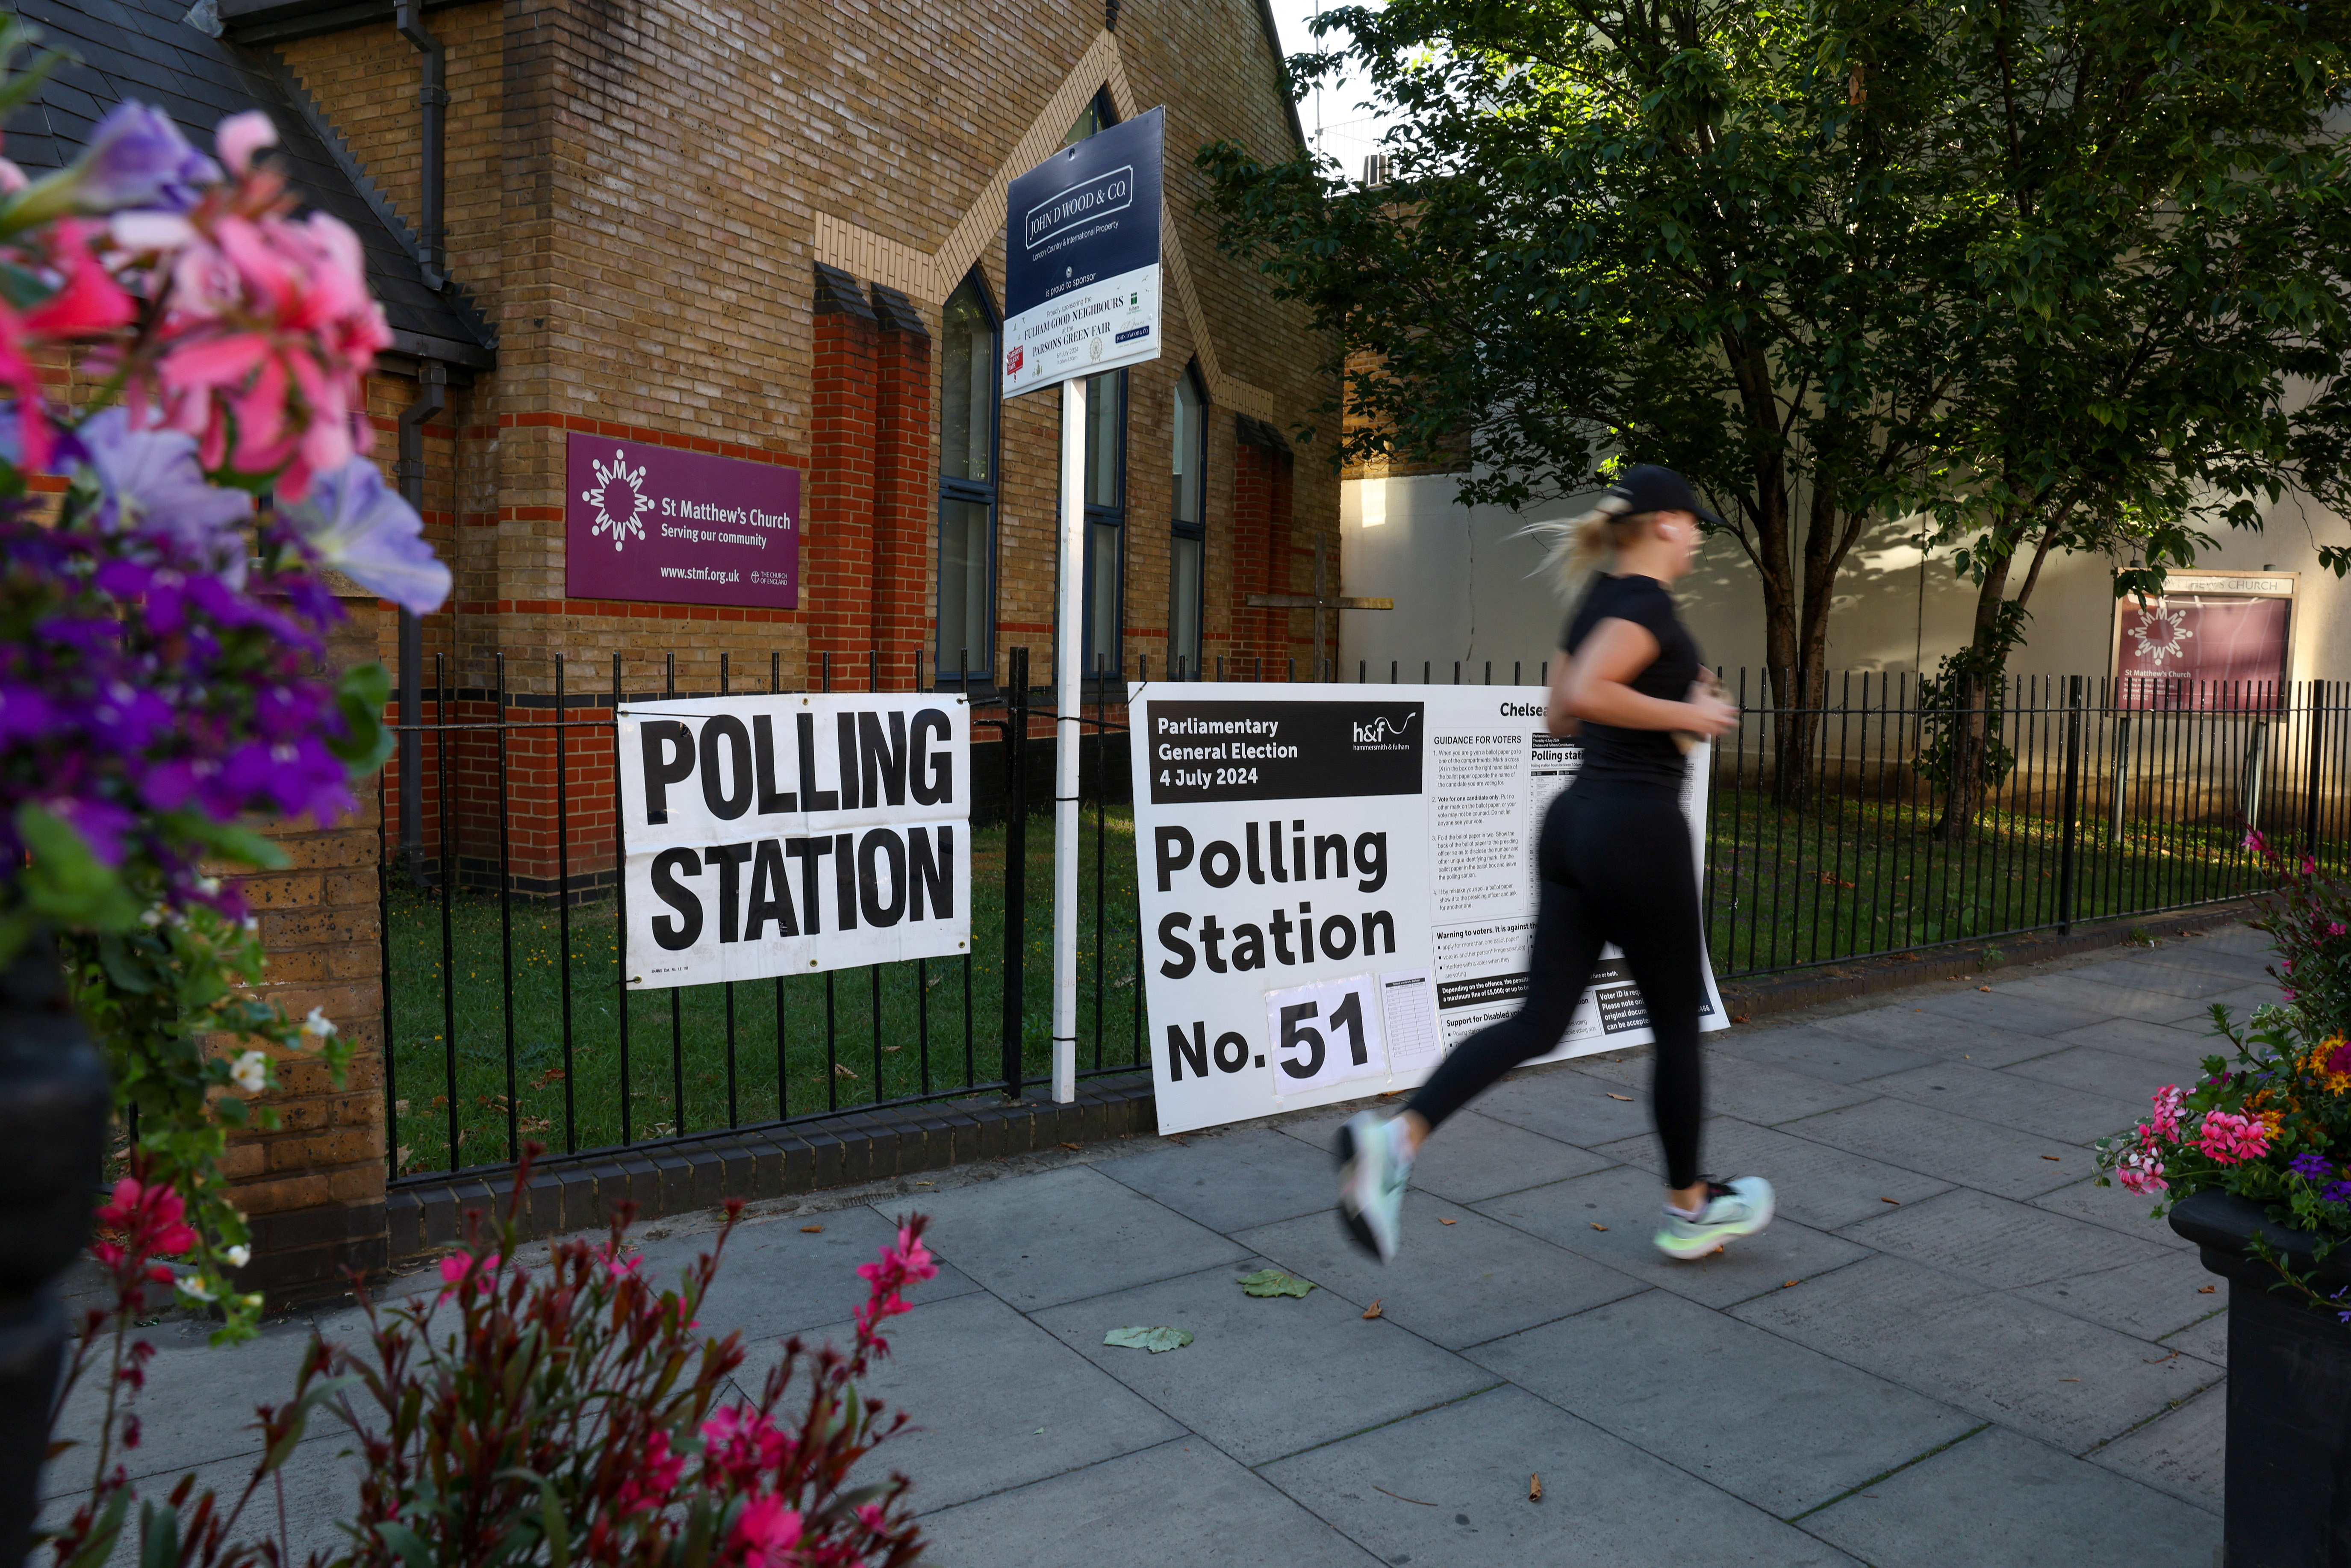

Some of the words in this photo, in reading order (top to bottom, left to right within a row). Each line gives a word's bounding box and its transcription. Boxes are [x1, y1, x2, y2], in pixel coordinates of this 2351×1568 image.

[1030, 210, 1052, 240] JOHN
[1054, 207, 1060, 222] D
[1062, 192, 1093, 218] WOOD
[1097, 189, 1105, 204] &
[1108, 180, 1125, 200] CO.
[1033, 249, 1046, 261] London,
[1047, 242, 1062, 253] Country
[1067, 229, 1094, 244] International
[1096, 220, 1119, 233] Property
[1046, 289, 1049, 297] is
[1051, 282, 1064, 296] proud
[1066, 280, 1071, 289] to
[1073, 272, 1096, 286] sponsor
[1025, 322, 1049, 340] FULHAM
[1052, 313, 1069, 328] GOOD
[1073, 295, 1123, 321] NEIGHBOURS
[1047, 307, 1061, 317] Proudly
[1062, 300, 1084, 312] sponsoring
[1034, 337, 1061, 357] PARSONS
[1064, 328, 1089, 345] GREEN
[1092, 321, 1110, 336] FAIR
[1008, 348, 1022, 359] PARSONS
[1008, 355, 1019, 365] GREEN
[1069, 347, 1078, 355] 2024
[662, 497, 676, 516] St
[681, 500, 746, 524] Matthew's
[750, 509, 790, 529] Church
[662, 523, 698, 542] Serving
[701, 531, 716, 541] our
[719, 532, 766, 549] community
[661, 567, 739, 583] www.stmf.org.uk
[2229, 580, 2277, 590] CHURCH
[1158, 717, 1279, 737] Parliamentary
[1353, 722, 1385, 743] h&f
[1158, 743, 1226, 760] General
[1232, 742, 1298, 759] Election
[1532, 751, 1562, 762] Polling
[640, 708, 953, 825] POLLING
[1160, 769, 1170, 786] 4
[1176, 769, 1211, 790] July
[1217, 767, 1258, 785] 2024
[1155, 819, 1387, 893] Polling
[651, 825, 954, 951] STATION
[1158, 902, 1396, 979] Station
[1437, 931, 1463, 939] Warning
[1508, 923, 1529, 932] against
[1442, 985, 1468, 994] Depending
[1600, 991, 1615, 1001] Voter
[1624, 989, 1628, 997] is
[1602, 1001, 1620, 1011] Please
[1621, 1000, 1634, 1008] note
[1635, 999, 1645, 1007] onl
[1604, 1010, 1627, 1021] original
[1628, 1008, 1648, 1017] docum
[1447, 1017, 1472, 1026] Support
[1484, 1011, 1510, 1020] Disabled
[1607, 1022, 1617, 1030] can
[1618, 1020, 1626, 1029] be
[1167, 1021, 1265, 1082] No.
[1280, 992, 1368, 1079] 51
